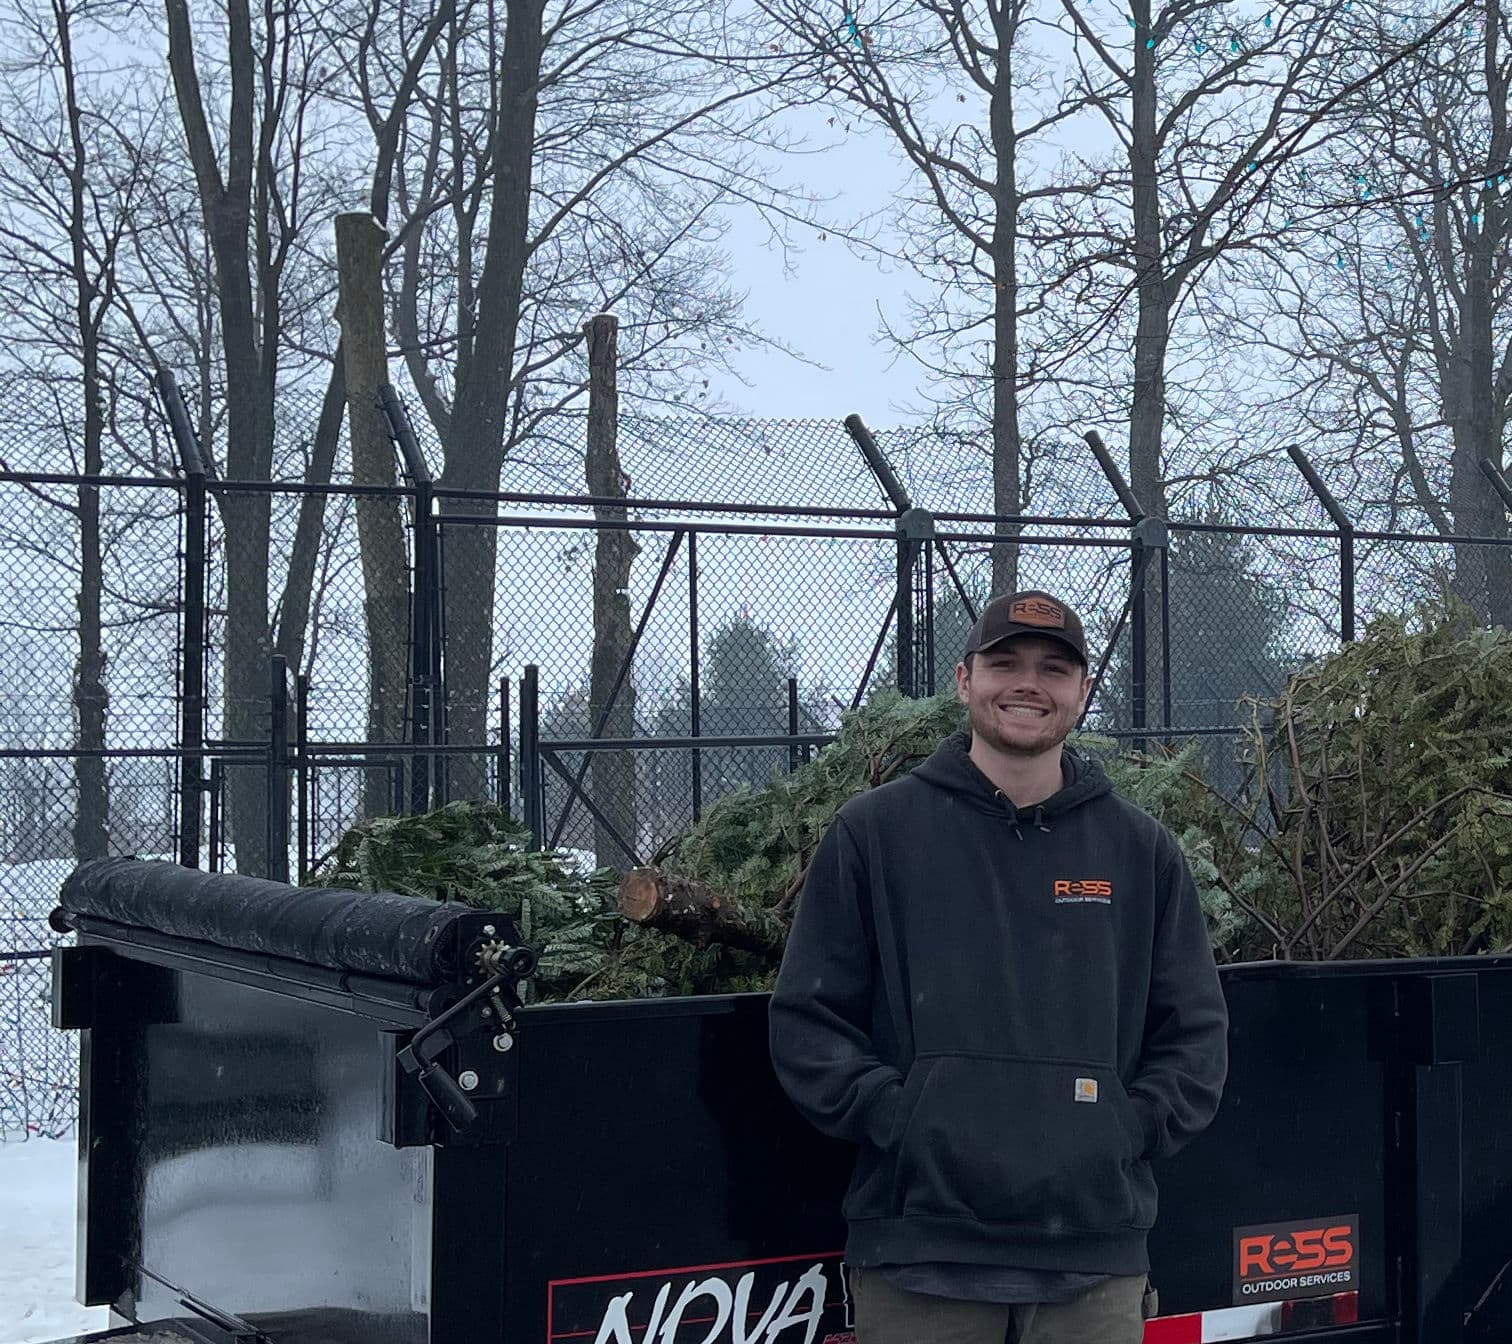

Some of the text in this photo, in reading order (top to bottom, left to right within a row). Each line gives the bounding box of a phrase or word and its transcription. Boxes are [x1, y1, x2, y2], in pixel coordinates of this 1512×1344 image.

[1240, 1225, 1353, 1277] ROSS
[1242, 1270, 1351, 1294] OUTDOOR SERVICES
